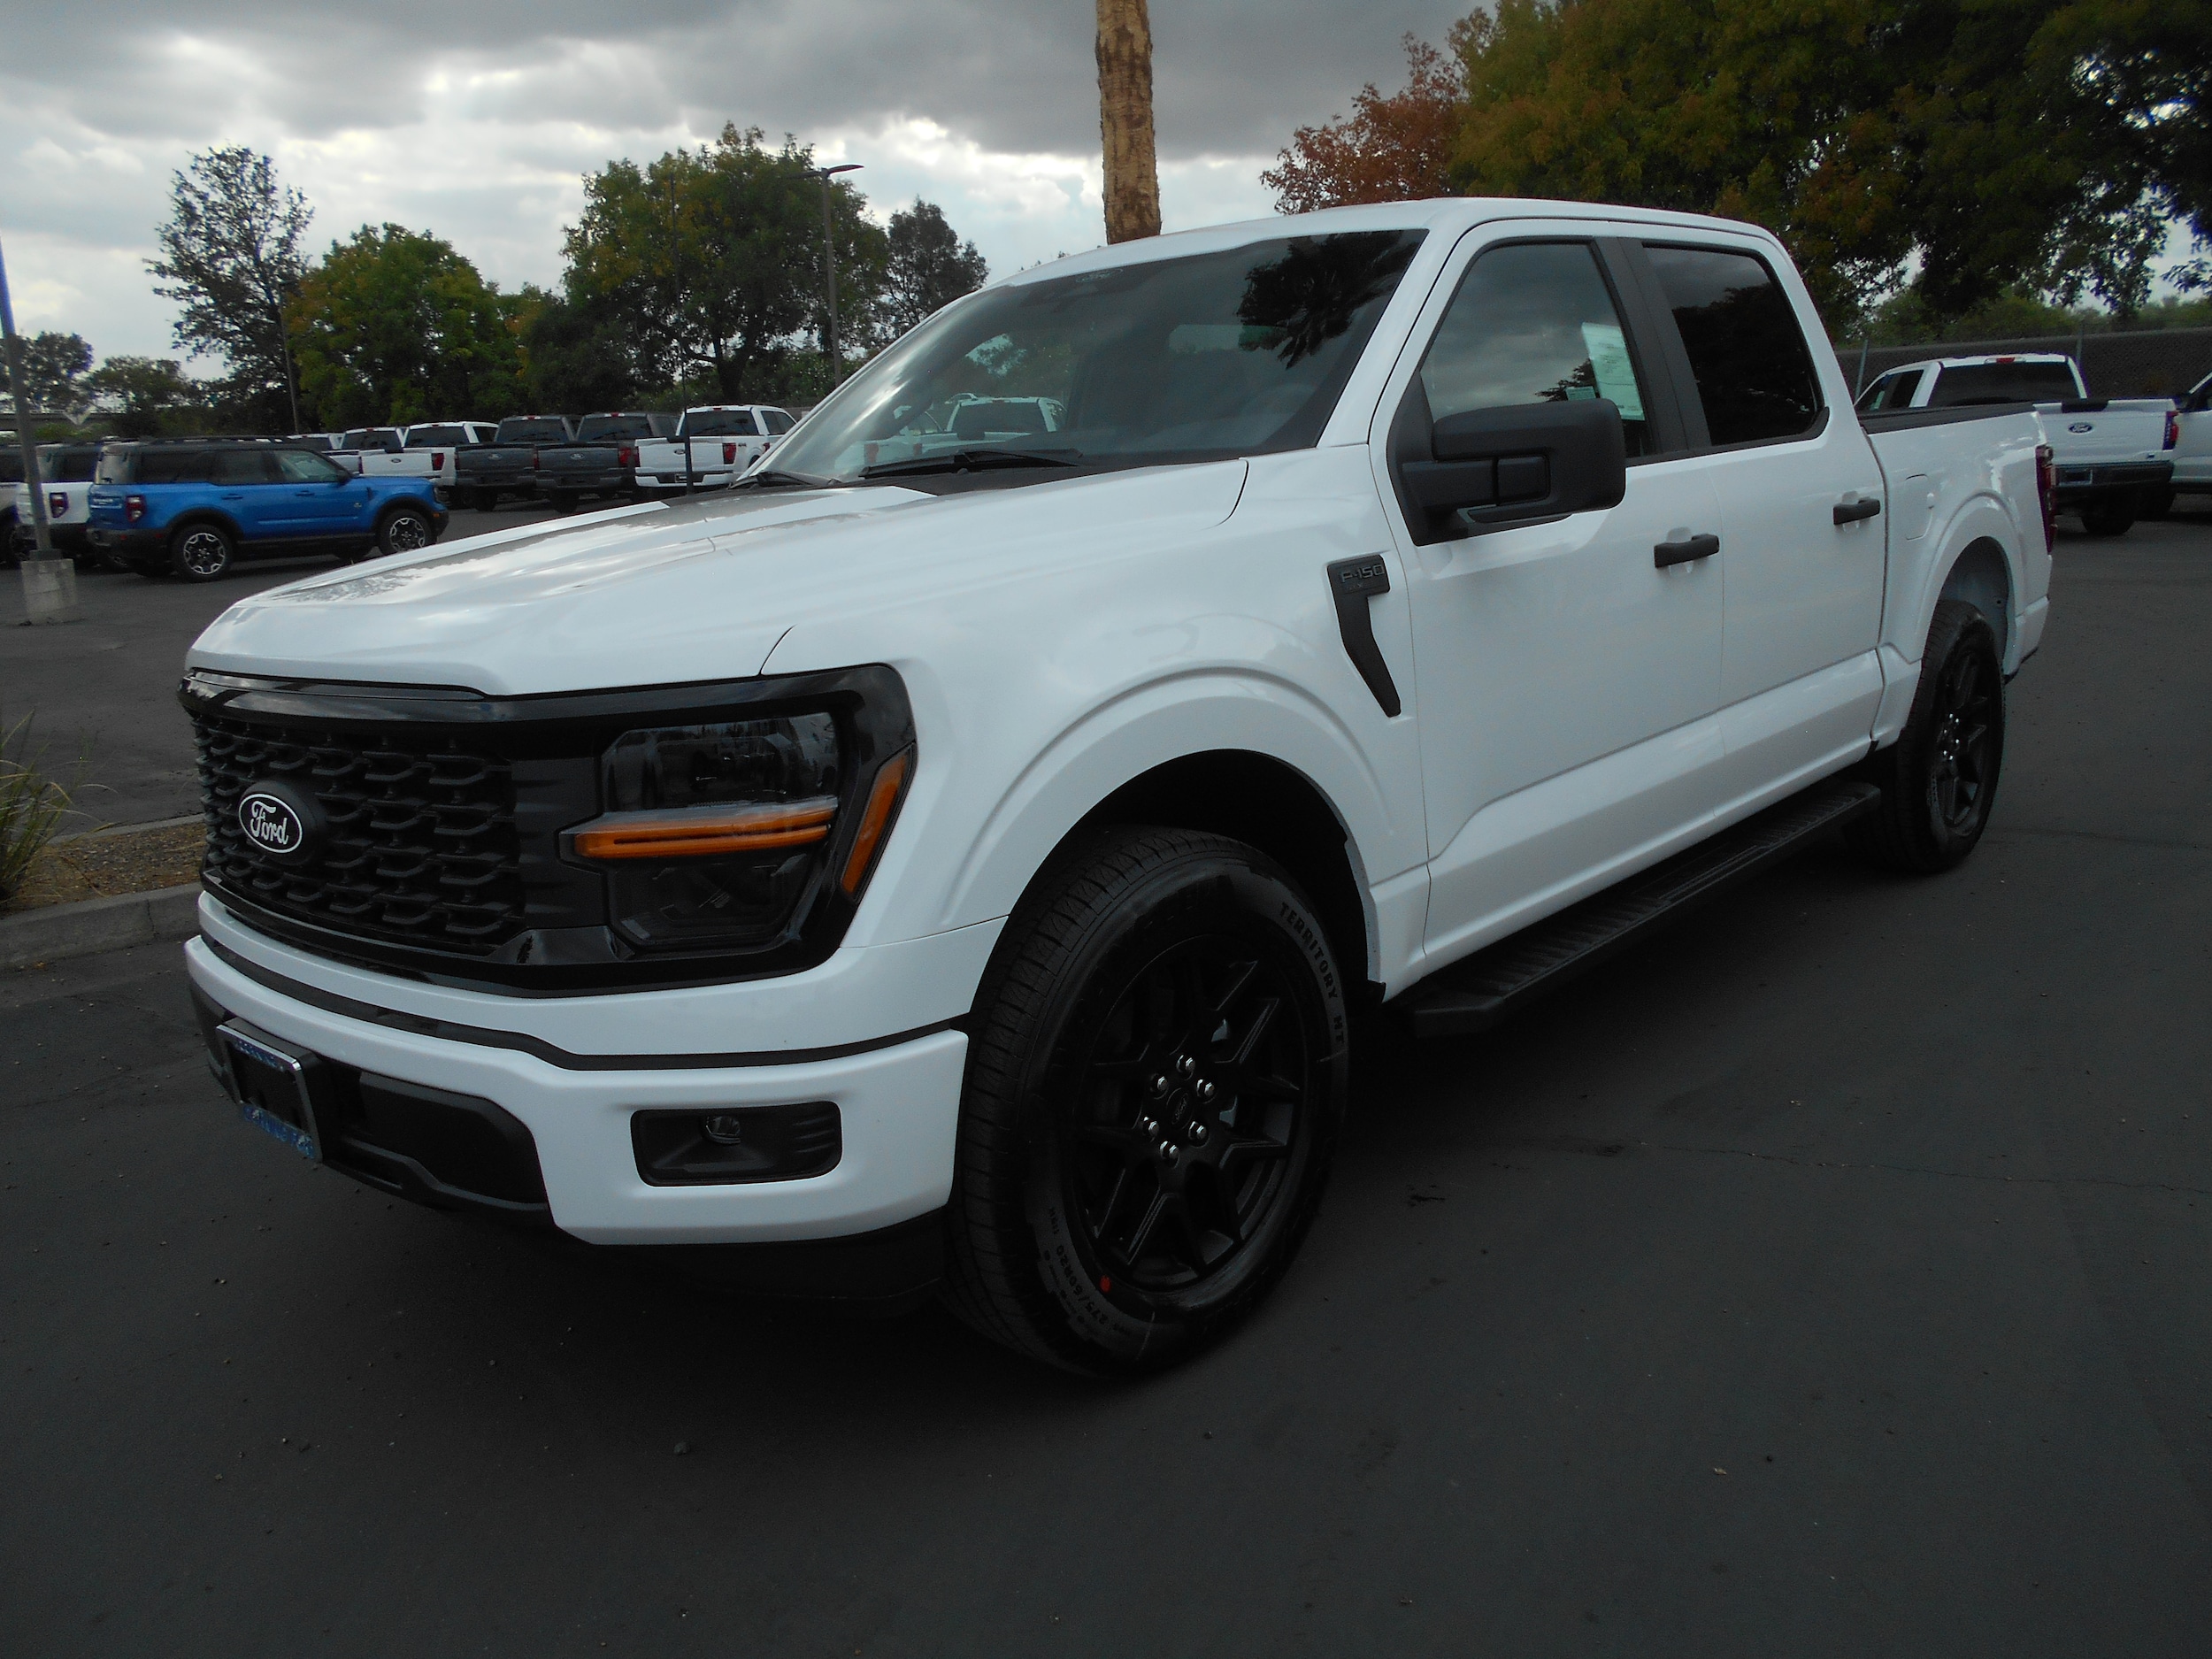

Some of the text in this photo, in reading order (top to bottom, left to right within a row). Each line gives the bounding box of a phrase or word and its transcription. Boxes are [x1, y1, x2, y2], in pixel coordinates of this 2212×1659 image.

[1340, 564, 1386, 582] F-150
[250, 800, 290, 845] Ford
[1280, 902, 1338, 998] TERRITORY
[1056, 1245, 1108, 1325] 275/60R20
